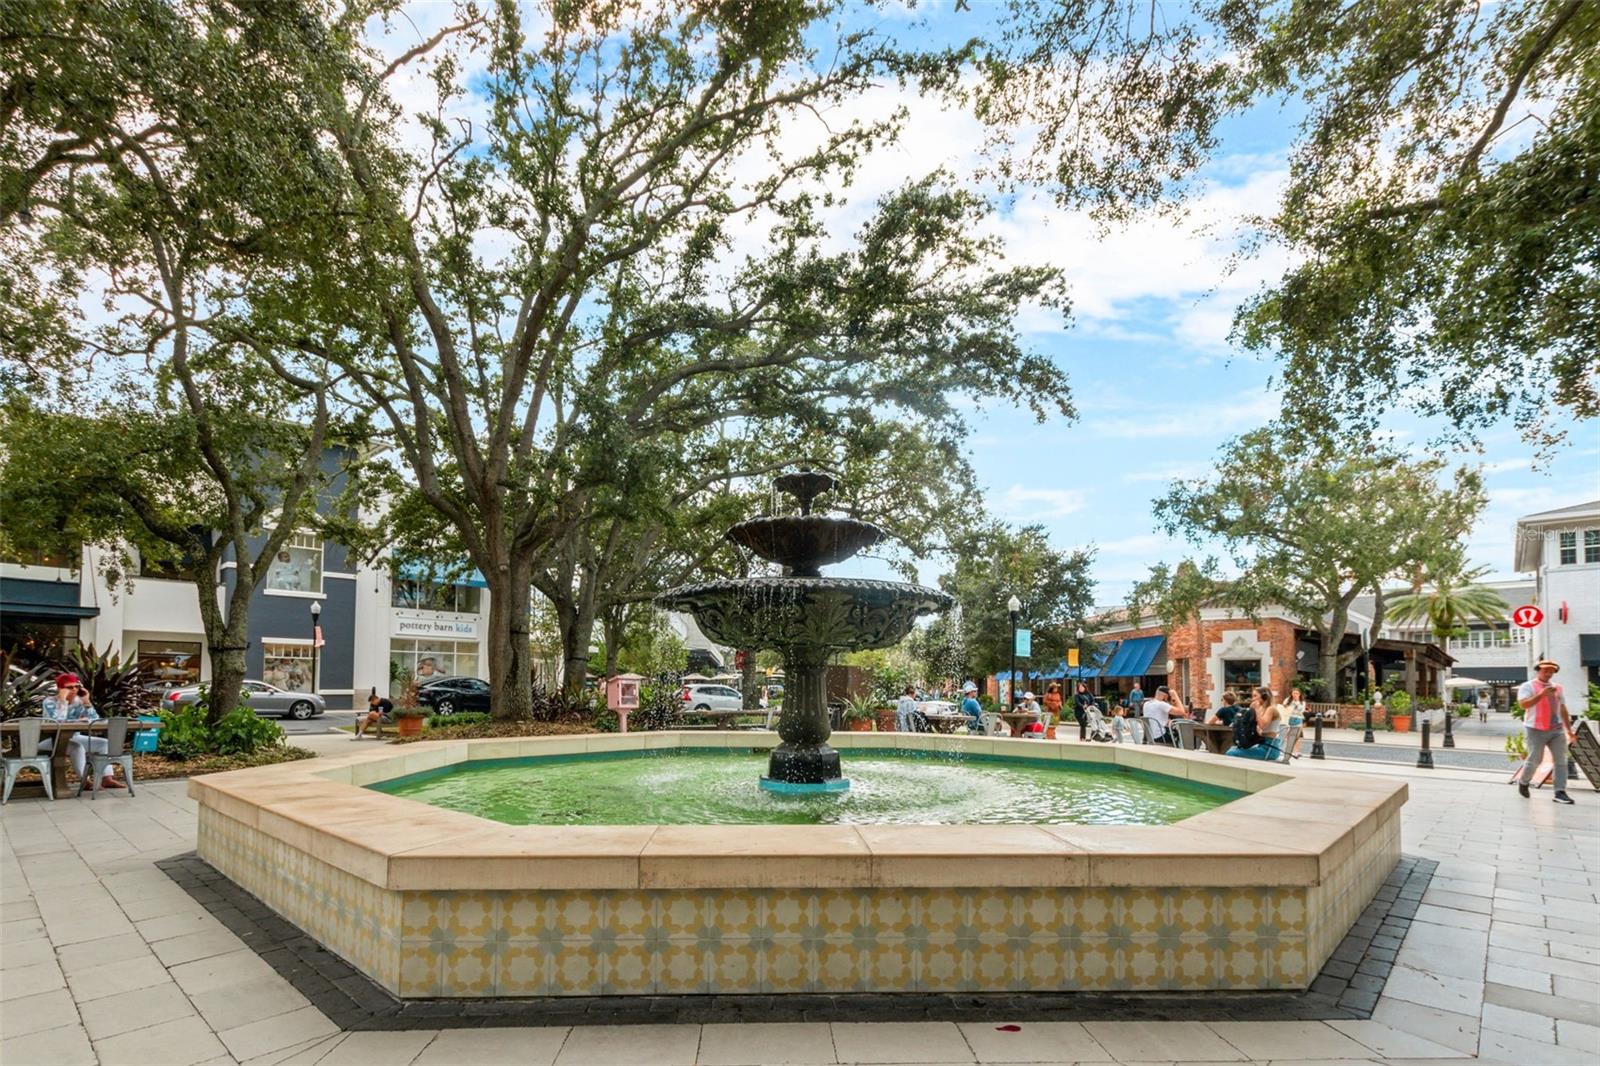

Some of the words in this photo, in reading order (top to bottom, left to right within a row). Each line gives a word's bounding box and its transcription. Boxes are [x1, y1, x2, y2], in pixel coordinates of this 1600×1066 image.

[400, 622, 432, 632] pottery
[434, 621, 453, 632] barn
[455, 624, 472, 633] kids
